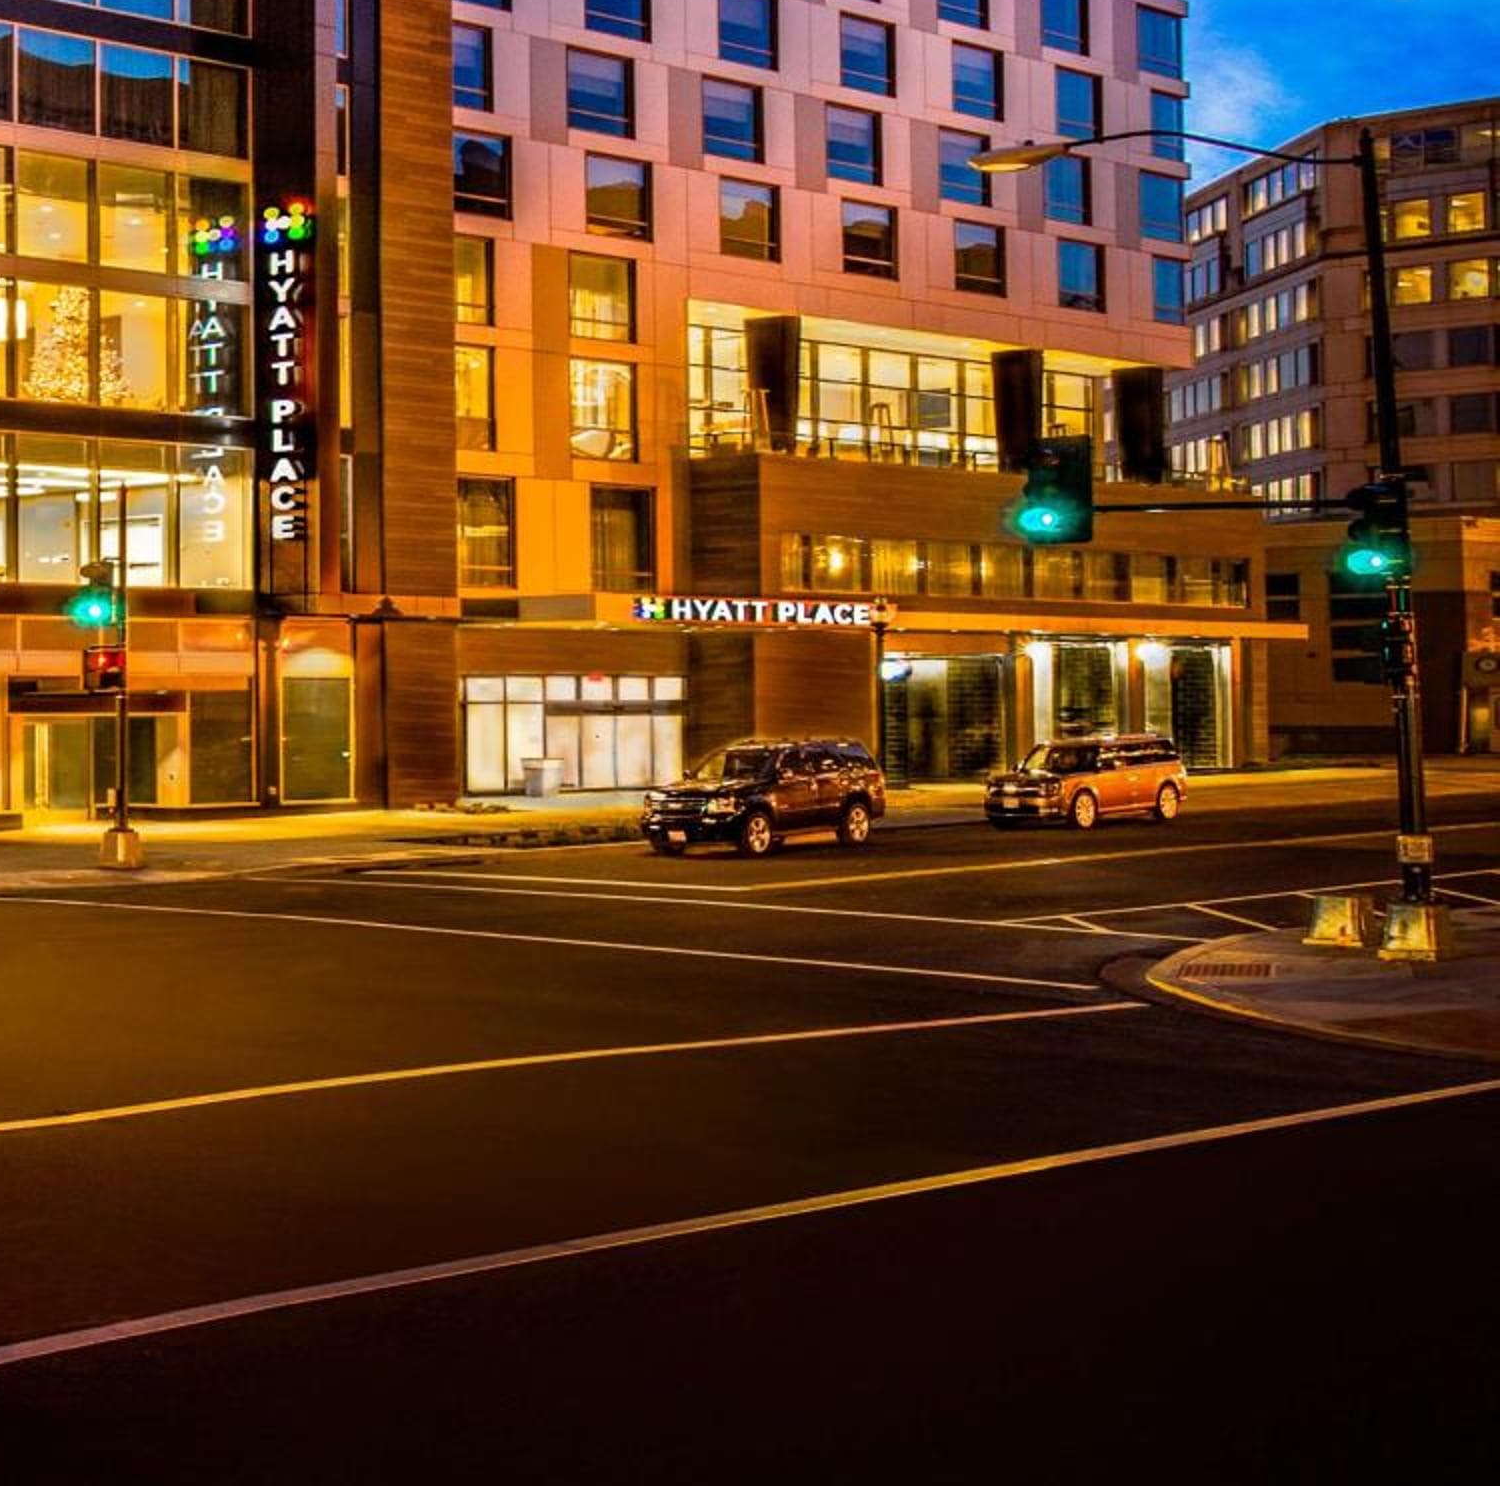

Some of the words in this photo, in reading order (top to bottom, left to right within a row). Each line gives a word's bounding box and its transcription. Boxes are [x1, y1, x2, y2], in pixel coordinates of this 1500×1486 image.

[268, 249, 296, 386] HYATT
[271, 398, 298, 540] PLACE
[671, 598, 767, 622] HYATT
[777, 602, 872, 625] PLACE
